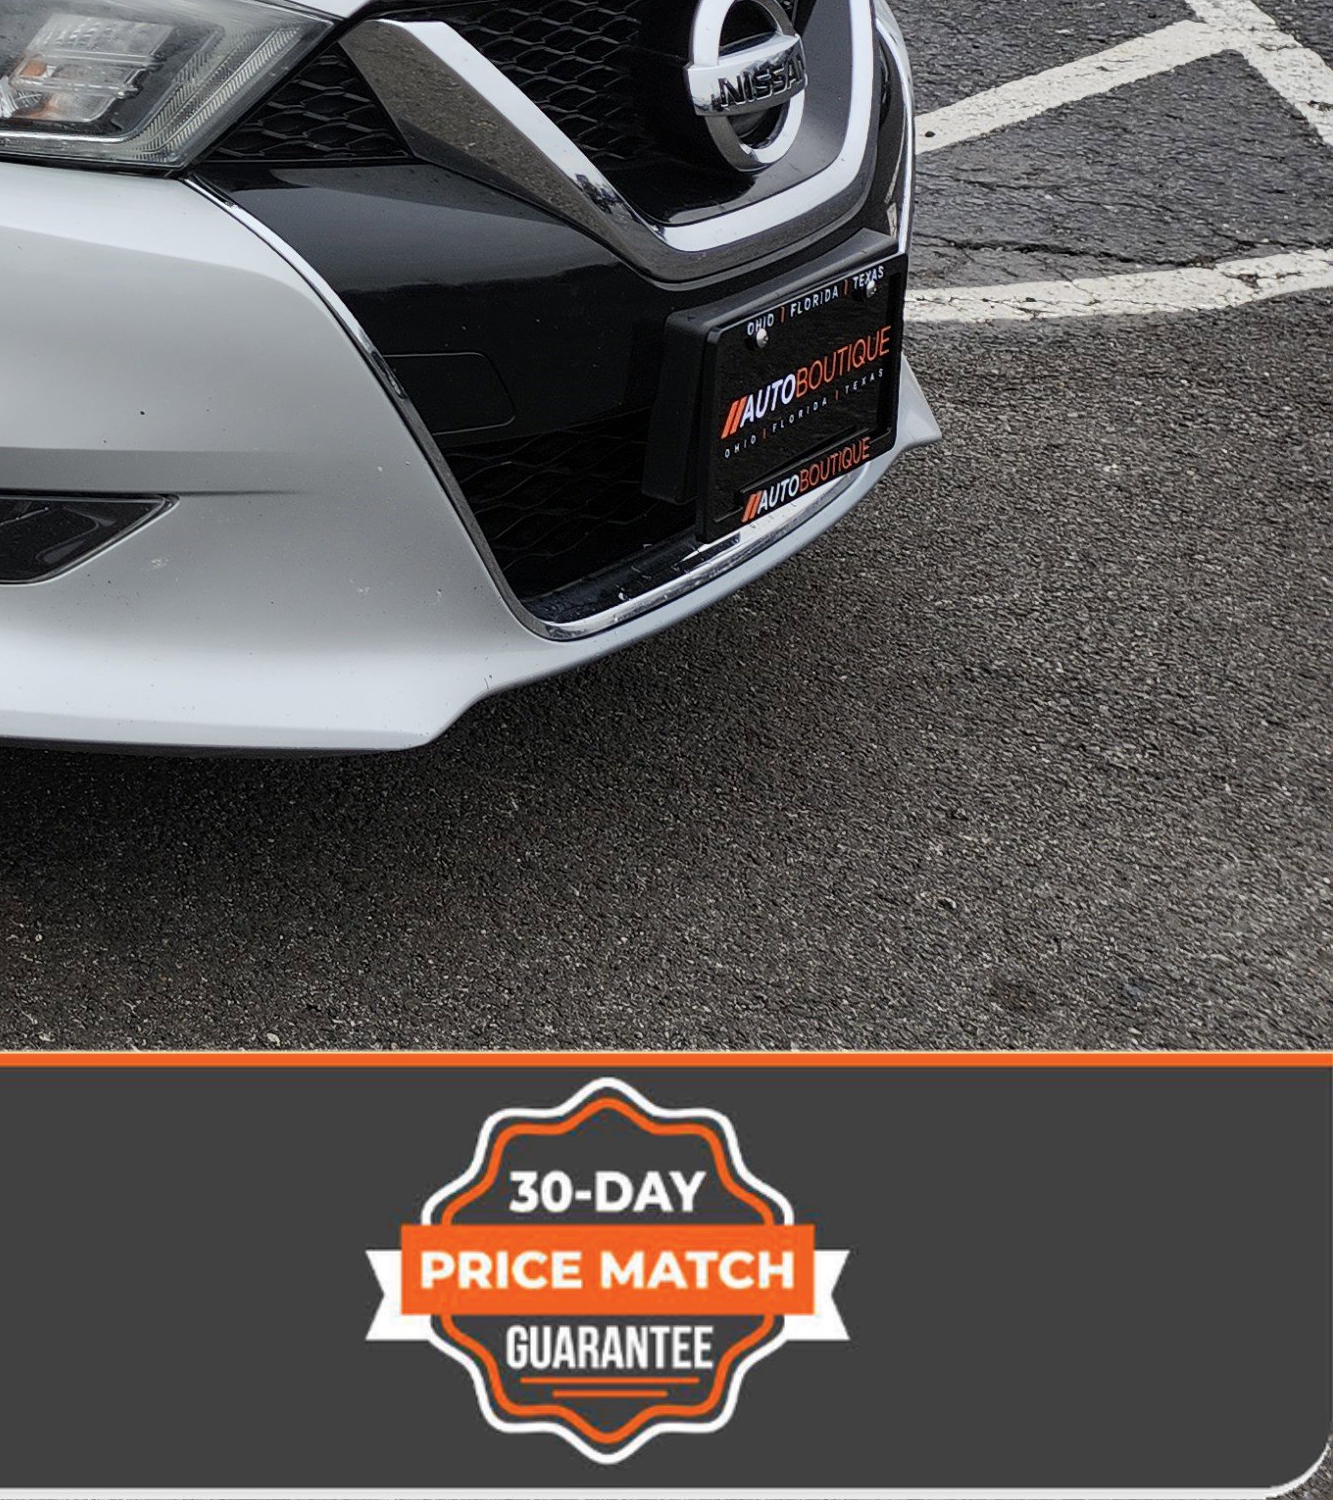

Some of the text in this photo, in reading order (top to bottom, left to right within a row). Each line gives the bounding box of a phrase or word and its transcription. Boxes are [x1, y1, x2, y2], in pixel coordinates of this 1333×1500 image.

[746, 265, 884, 336] OHIO FLORIDA TEXAS
[724, 368, 883, 459] OHIO FLORIDA TEXAS
[739, 325, 892, 429] AUTOBOUTIQUE
[756, 436, 871, 514] AUTOBOUTIQUE
